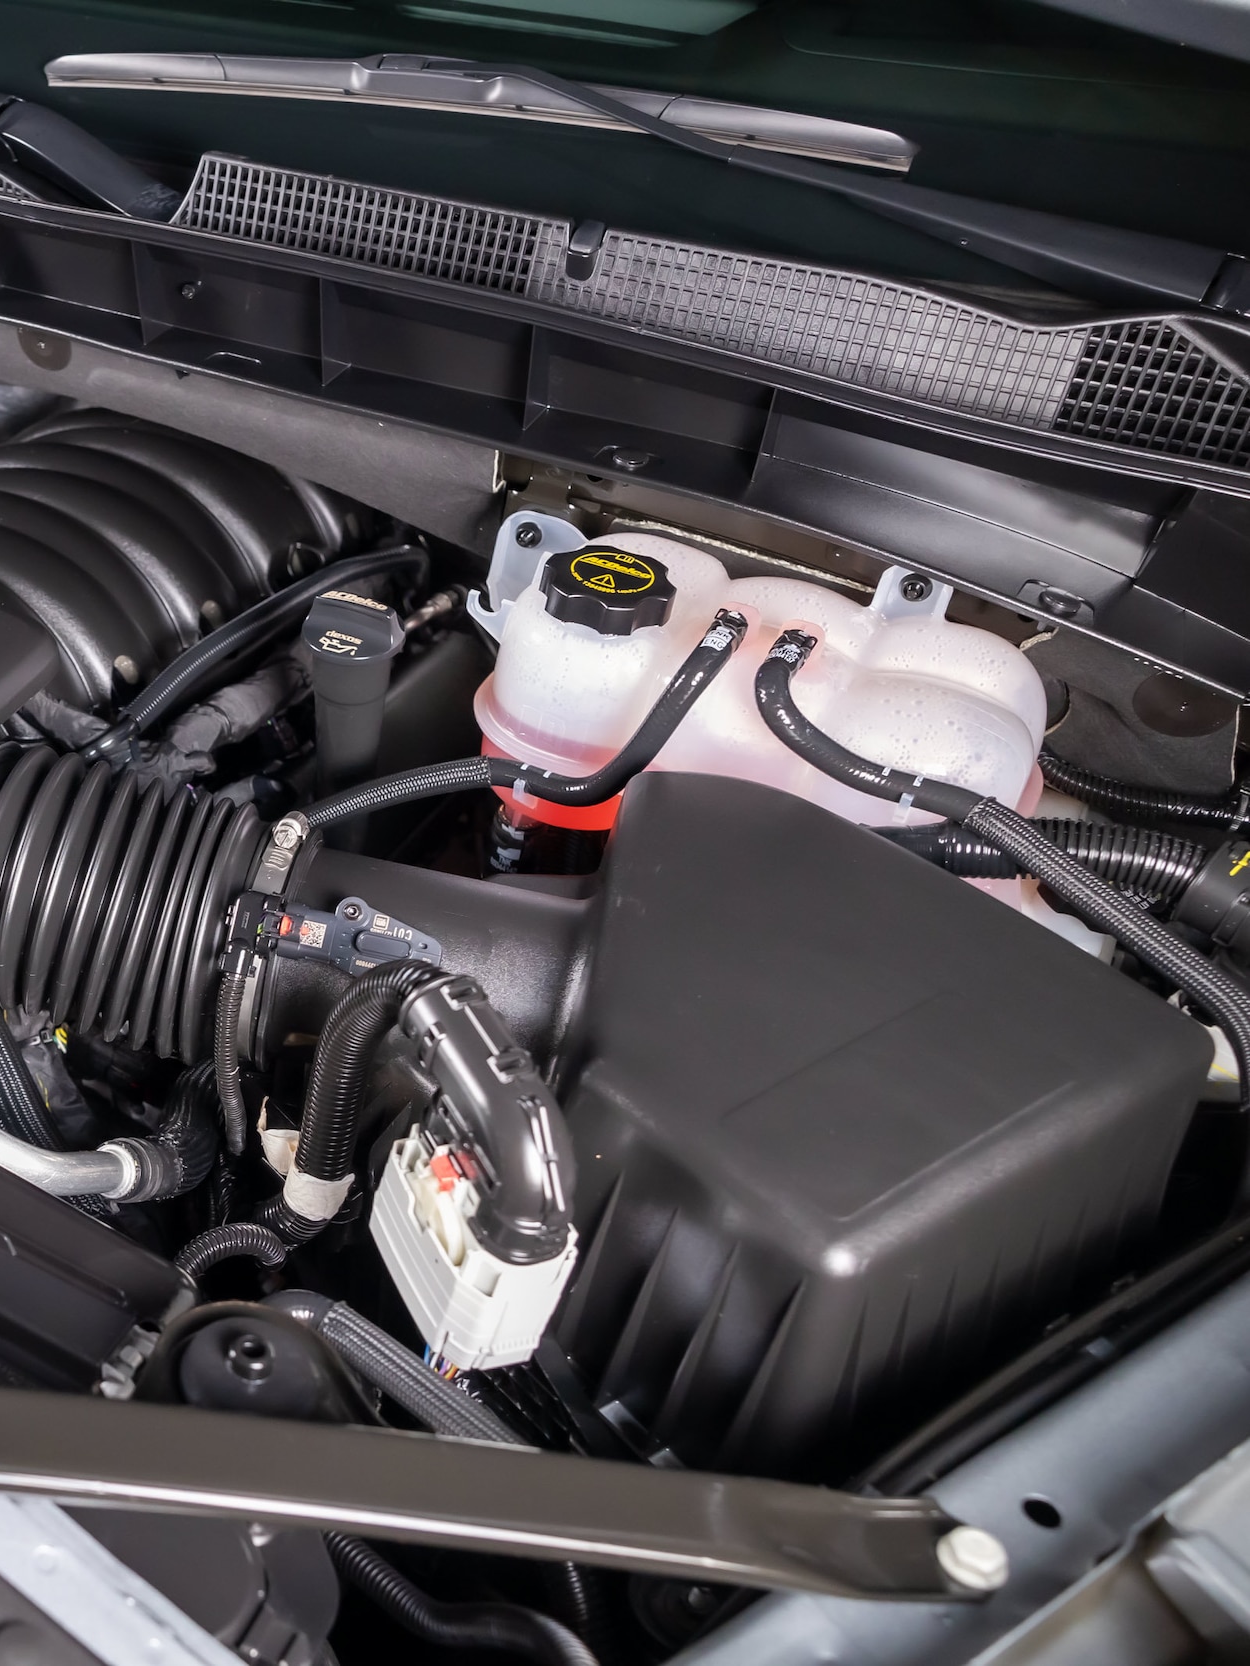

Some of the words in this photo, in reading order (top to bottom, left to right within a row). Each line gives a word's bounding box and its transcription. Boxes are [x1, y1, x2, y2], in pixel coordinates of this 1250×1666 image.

[579, 556, 653, 579] ACDelco
[320, 590, 388, 611] ACDelco
[325, 630, 364, 645] dexos
